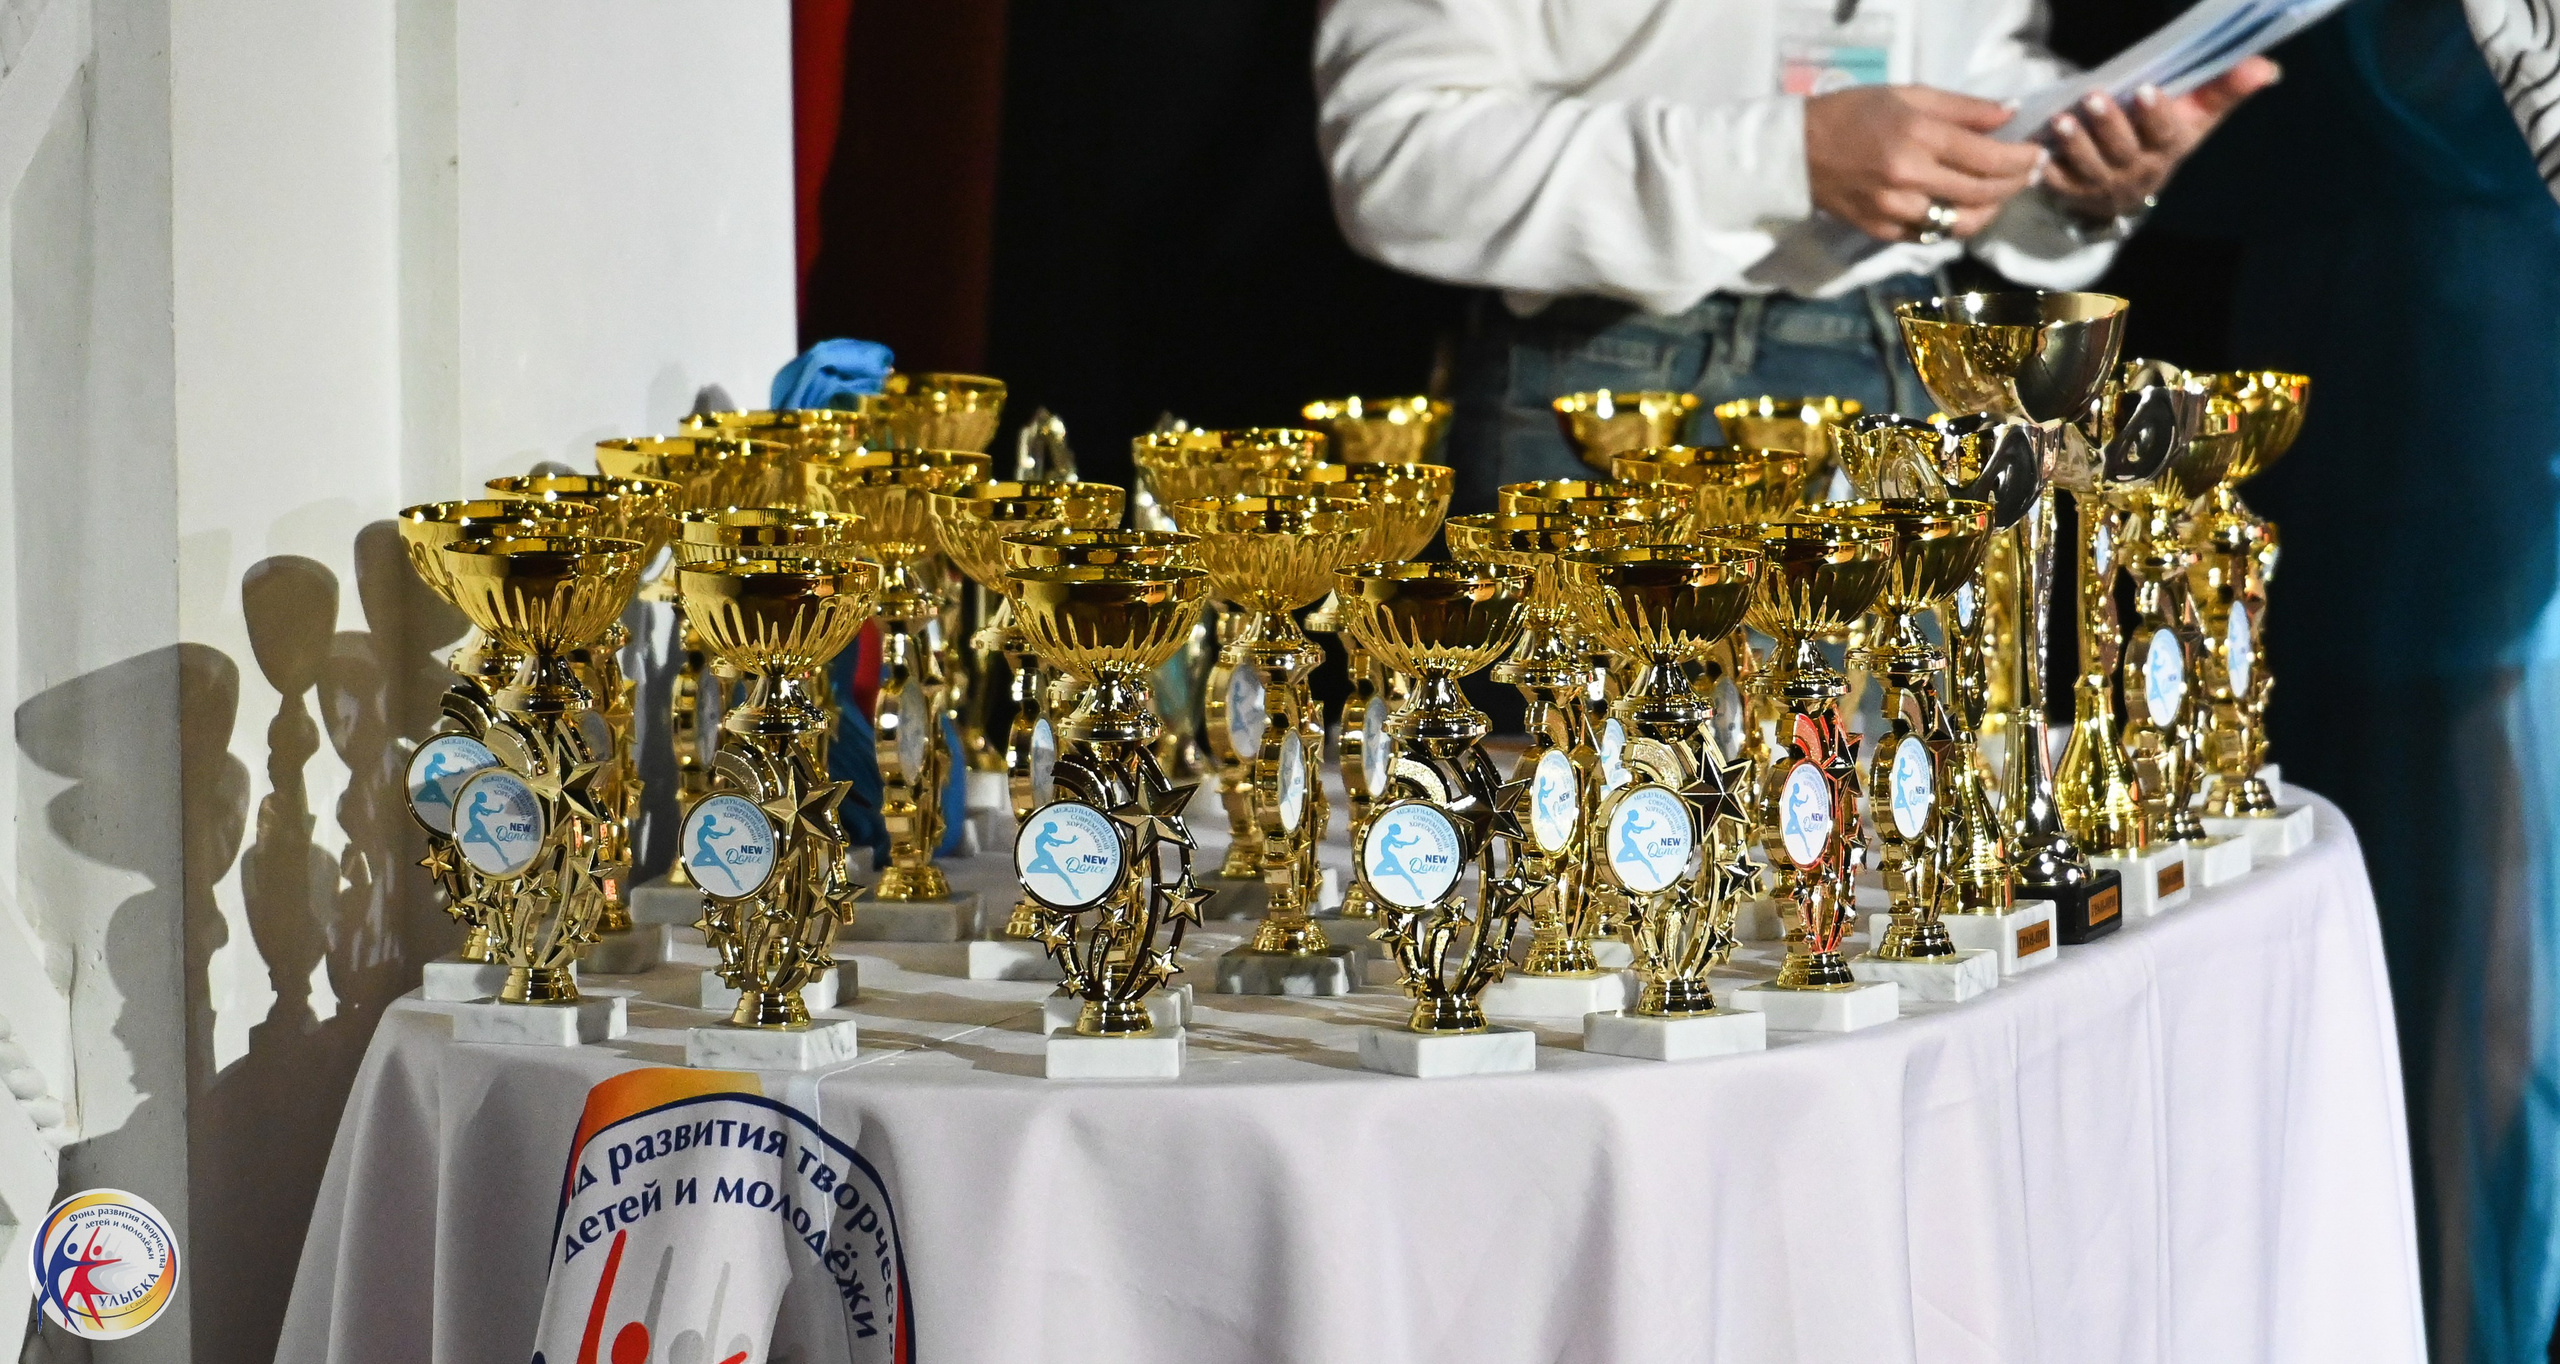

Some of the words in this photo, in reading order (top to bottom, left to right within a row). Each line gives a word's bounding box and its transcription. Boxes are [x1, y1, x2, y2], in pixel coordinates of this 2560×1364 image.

[1811, 813, 1823, 822] NEW
[496, 825, 532, 842] Dance
[510, 822, 531, 832] NEW
[741, 845, 763, 854] NEW
[1647, 841, 1681, 858] Dance
[1660, 837, 1681, 846] NEW
[726, 848, 762, 865] Dance
[1083, 854, 1108, 865] NEW
[1425, 854, 1448, 864] NEW
[1065, 857, 1107, 874] Dance
[1409, 857, 1447, 874] Dance
[608, 1119, 788, 1186] развития
[564, 1178, 662, 1264] детей
[675, 1177, 697, 1206] и
[713, 1177, 877, 1338] молодёжи
